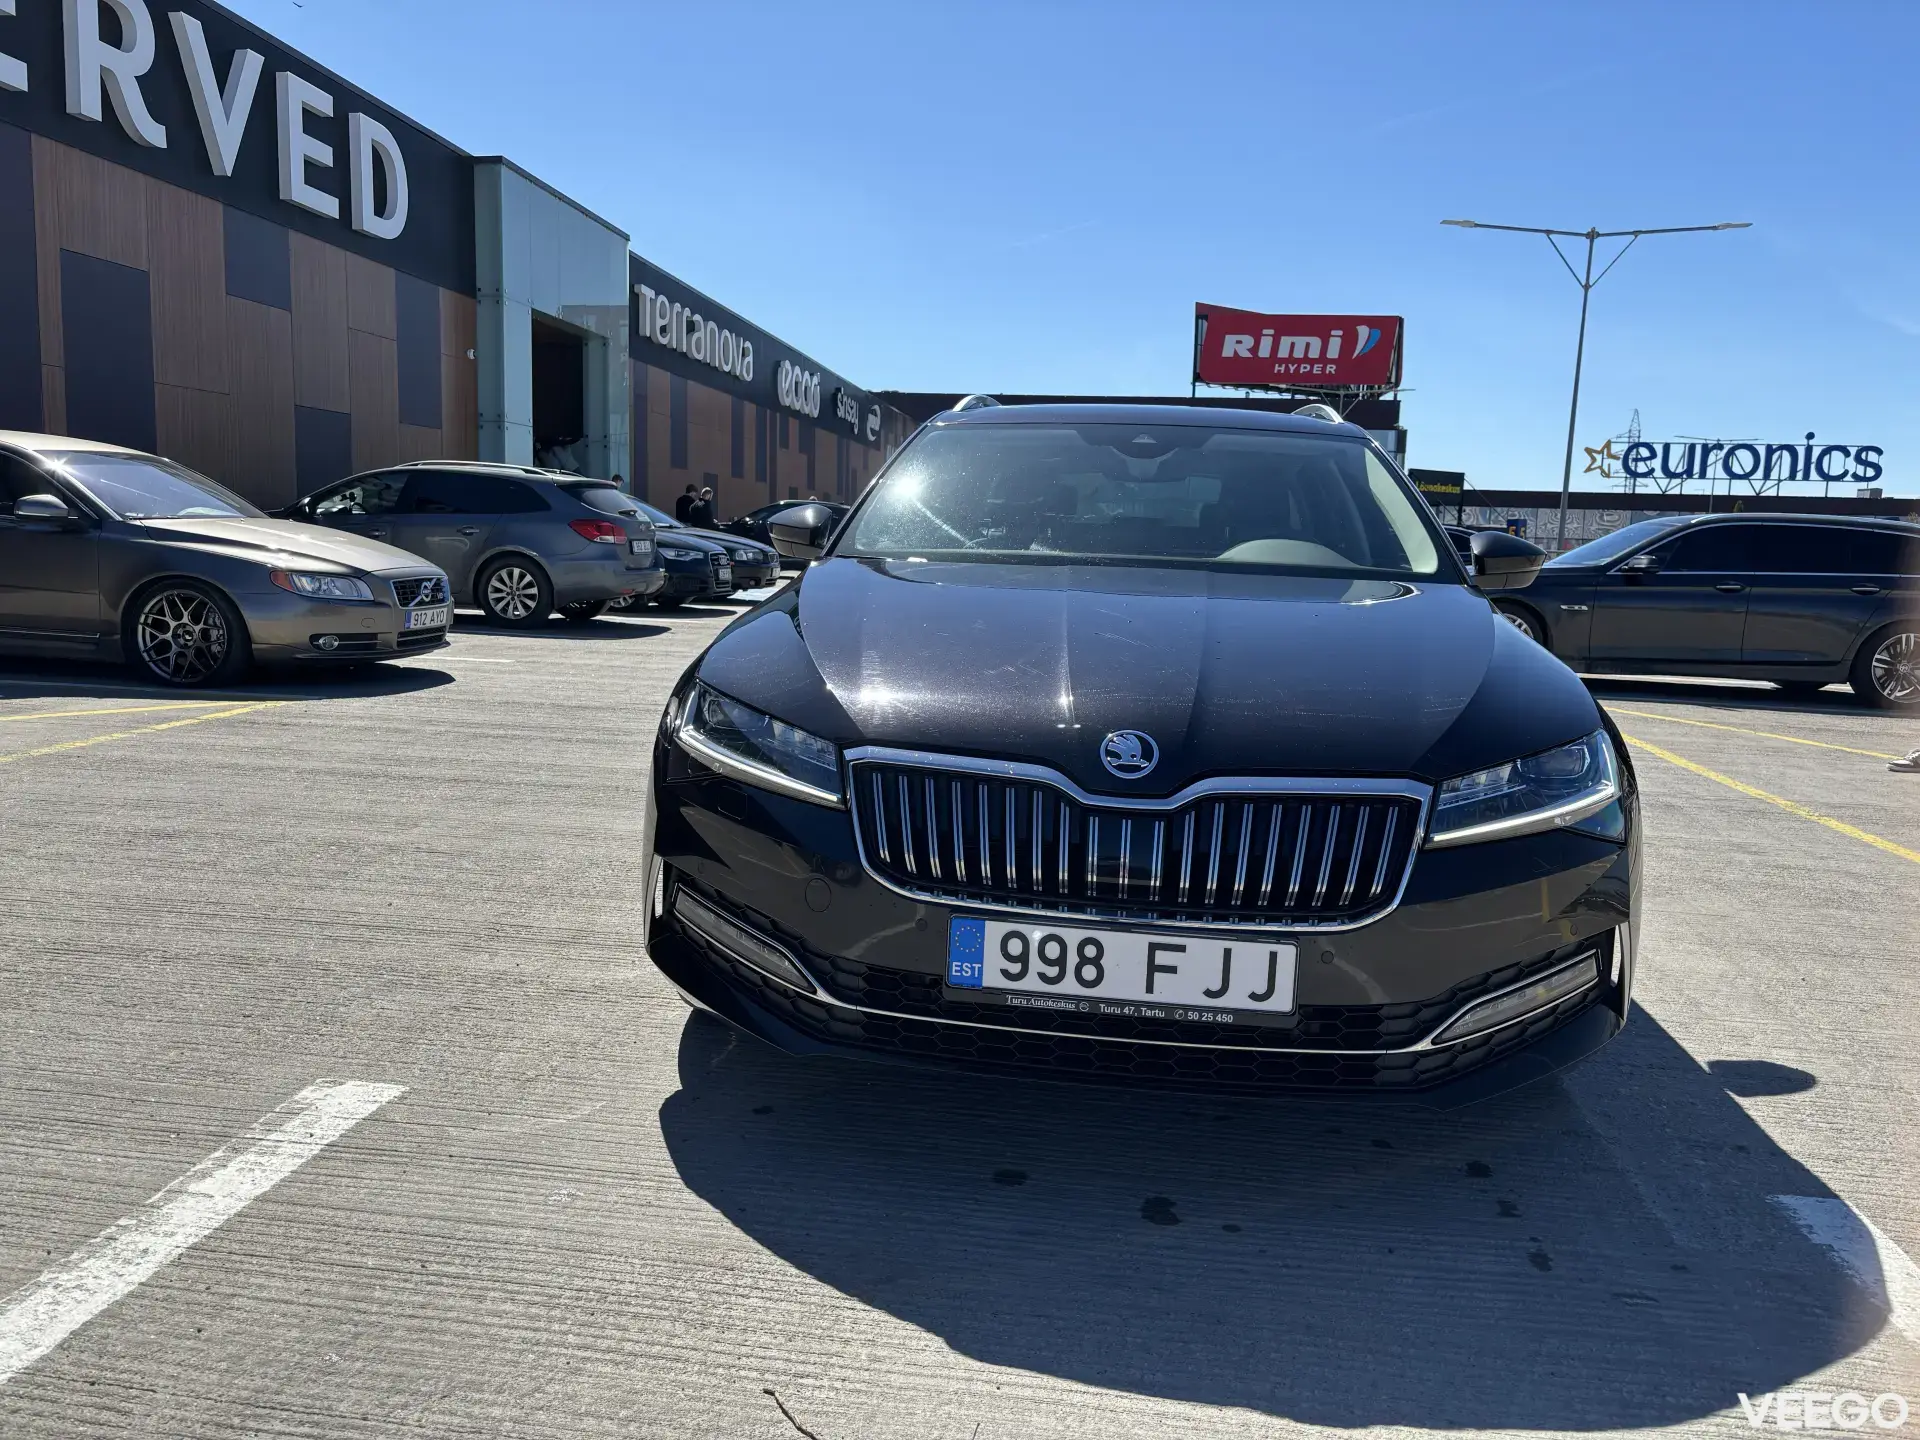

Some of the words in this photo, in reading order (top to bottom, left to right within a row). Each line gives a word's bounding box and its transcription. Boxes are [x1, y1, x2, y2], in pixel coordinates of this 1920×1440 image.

[1274, 363, 1337, 375] HYPER
[778, 359, 820, 418] ecco
[837, 386, 859, 435] sinsay
[1622, 431, 1884, 482] euronics
[413, 612, 428, 627] 912
[429, 609, 445, 625] AYO
[1000, 930, 1105, 989] 998
[952, 961, 982, 978] EST
[1006, 995, 1027, 1005] Turu
[1029, 997, 1076, 1010] Autokeskus
[1099, 1003, 1121, 1014] Turu
[1123, 1006, 1138, 1017] 47,
[1140, 1007, 1165, 1018] Tartu
[1187, 1011, 1199, 1020] 50
[1201, 1012, 1213, 1021] 25
[1215, 1013, 1233, 1023] 450
